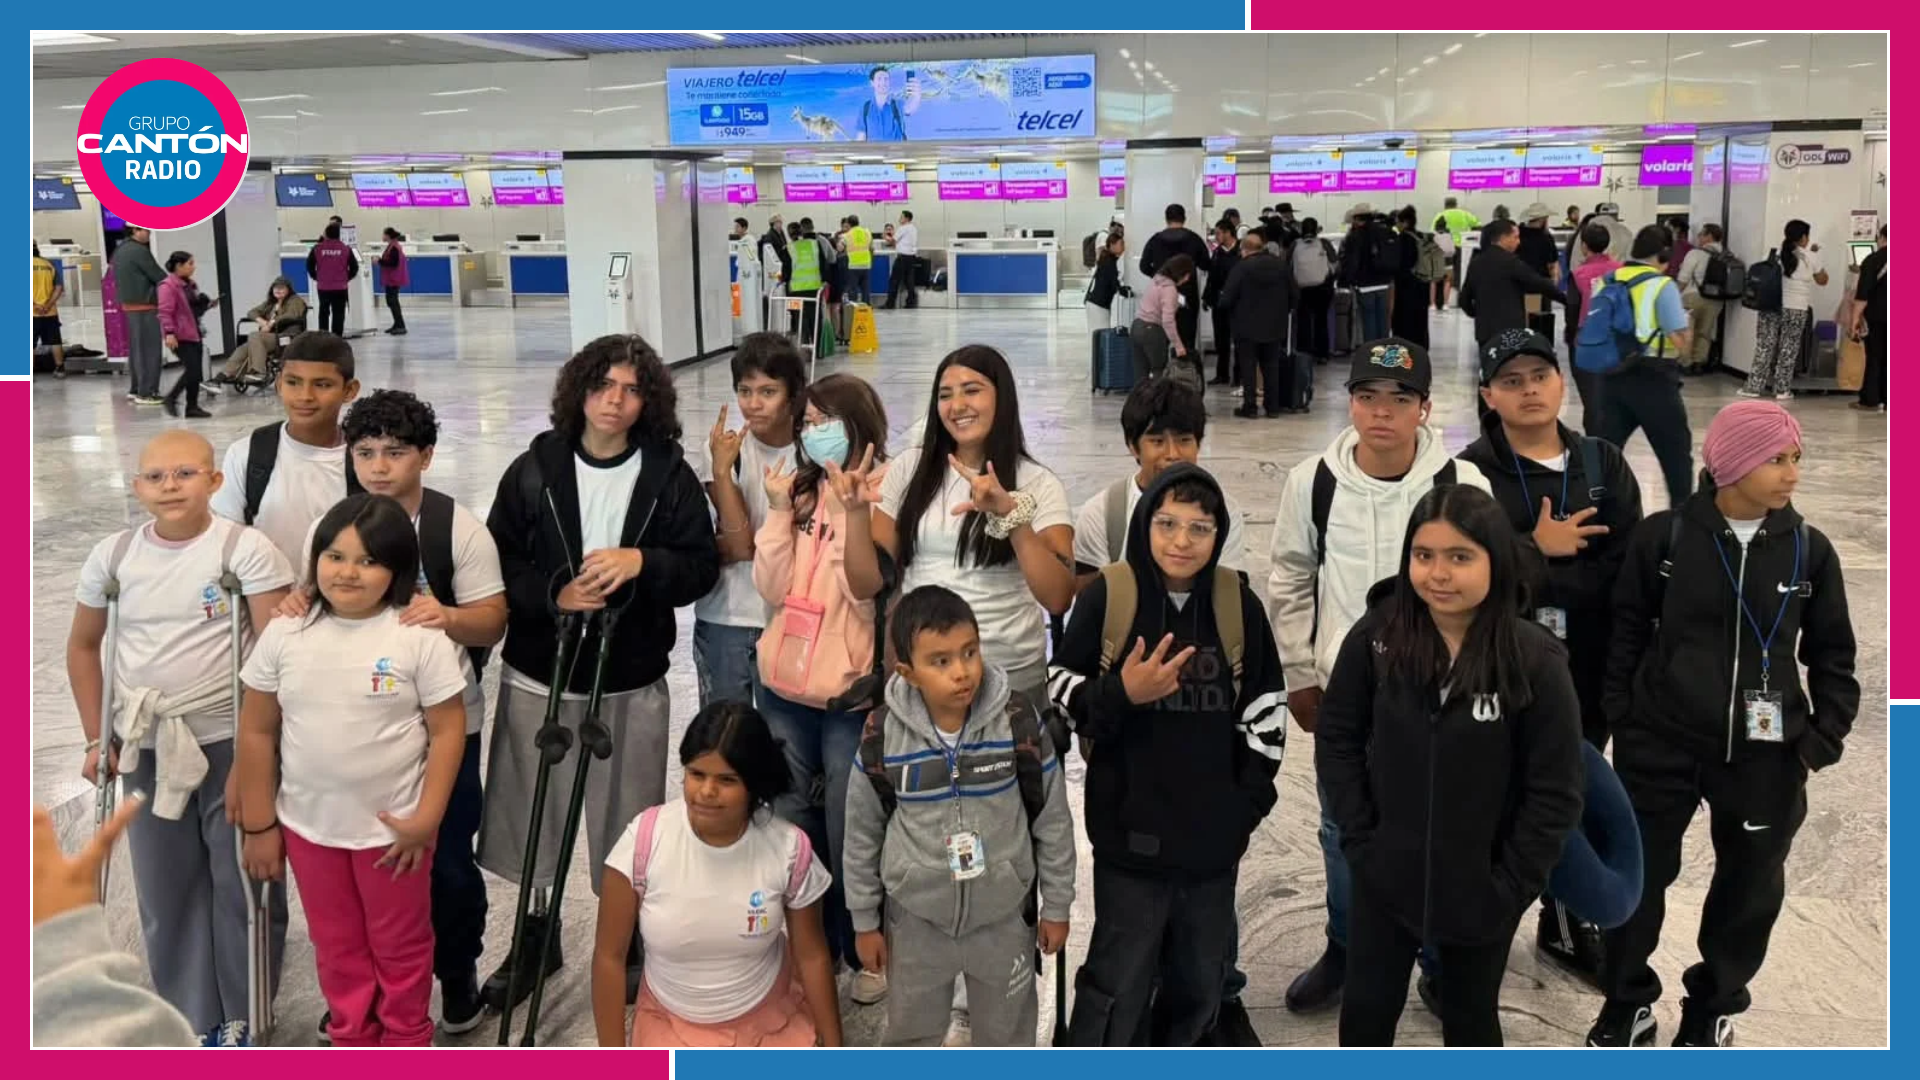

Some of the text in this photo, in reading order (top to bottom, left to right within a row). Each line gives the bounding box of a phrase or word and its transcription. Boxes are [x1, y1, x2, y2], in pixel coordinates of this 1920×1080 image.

[684, 69, 787, 88] VIAJERO telcel
[738, 107, 766, 121] 15GB
[1017, 109, 1084, 131] telcel
[1828, 152, 1850, 162] WiFi
[1643, 159, 1694, 171] volaris
